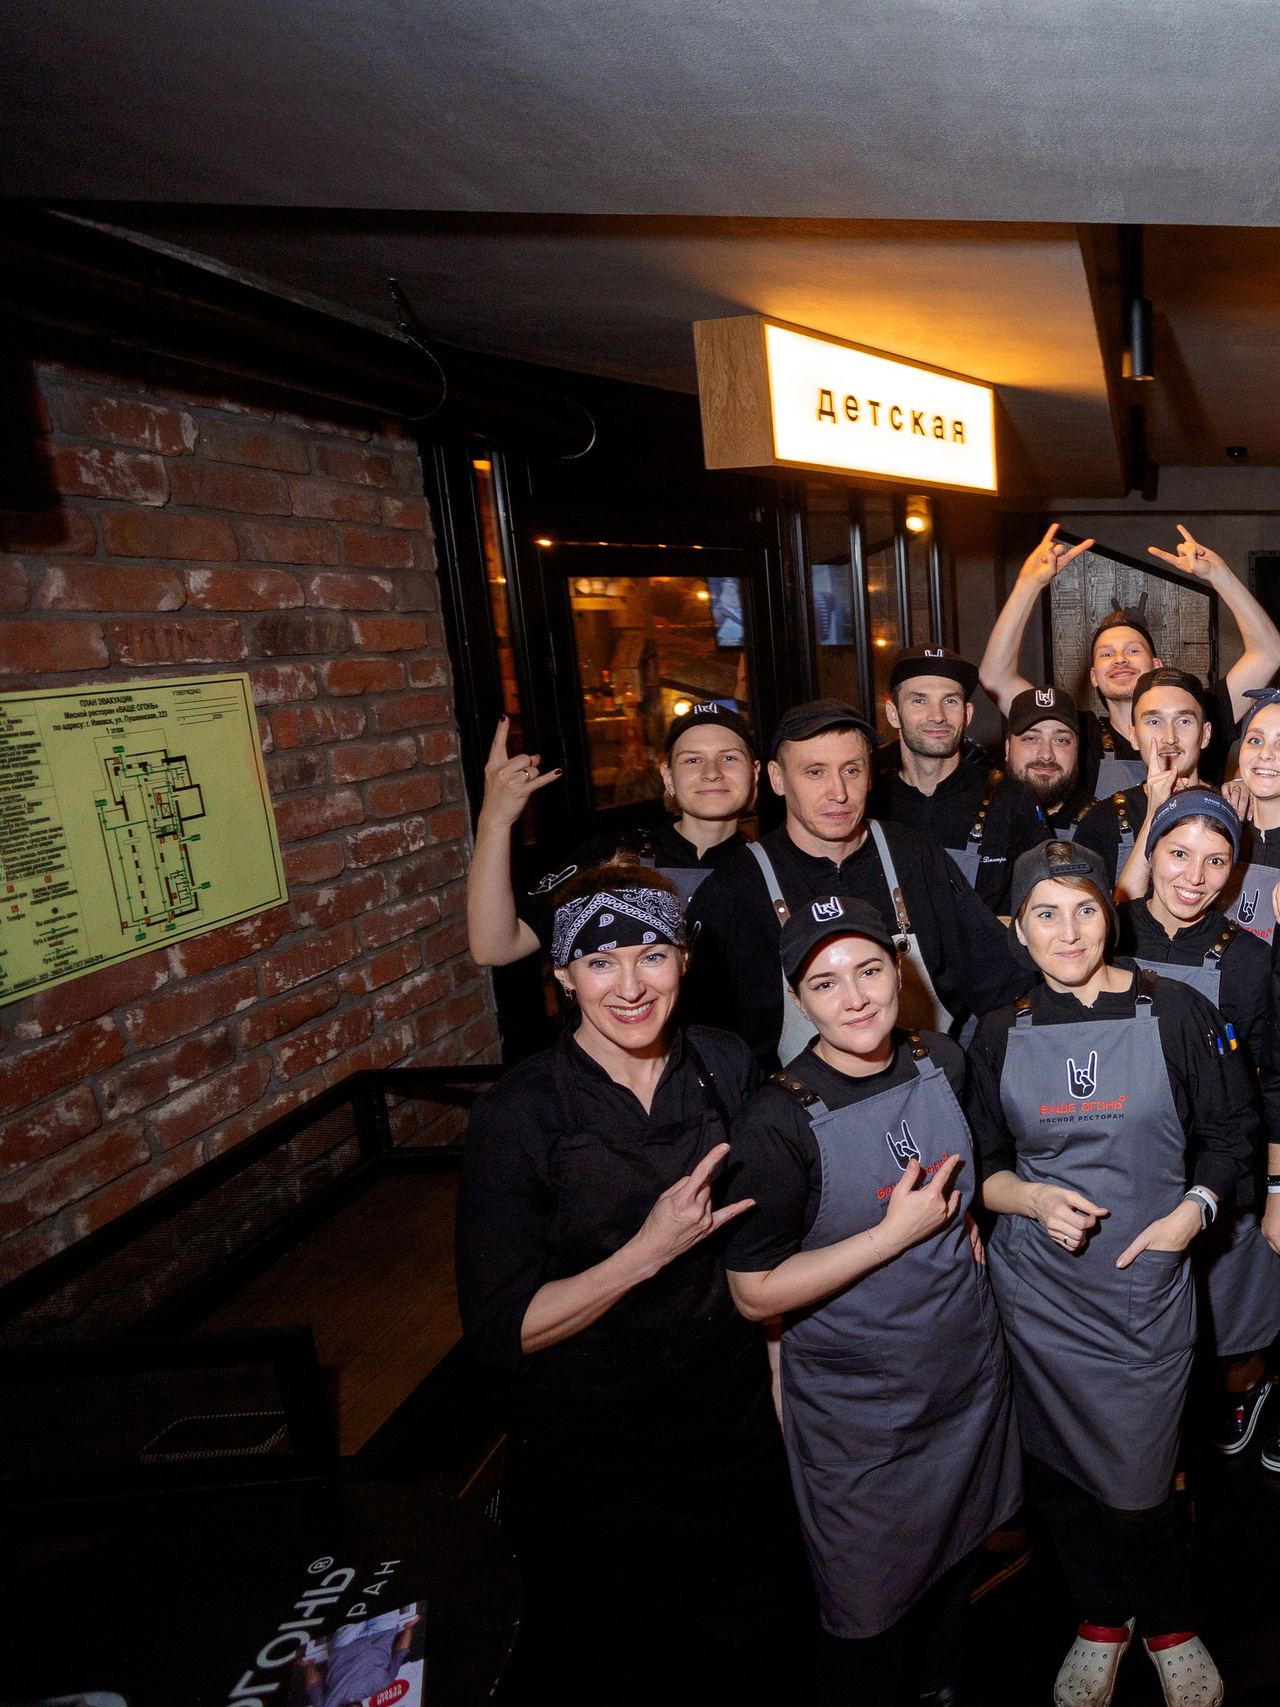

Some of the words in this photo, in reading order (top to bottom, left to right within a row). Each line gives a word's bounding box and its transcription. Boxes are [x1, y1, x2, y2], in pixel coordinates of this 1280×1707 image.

[816, 387, 966, 444] детская
[80, 699, 97, 707] ПЛАН
[98, 696, 133, 705] ЭВАКУАЦИИ
[1080, 1100, 1123, 1112] ОГОНЬ
[1040, 1115, 1075, 1124] МЯСНОЙ
[1078, 1113, 1124, 1122] РЕСТОРАН
